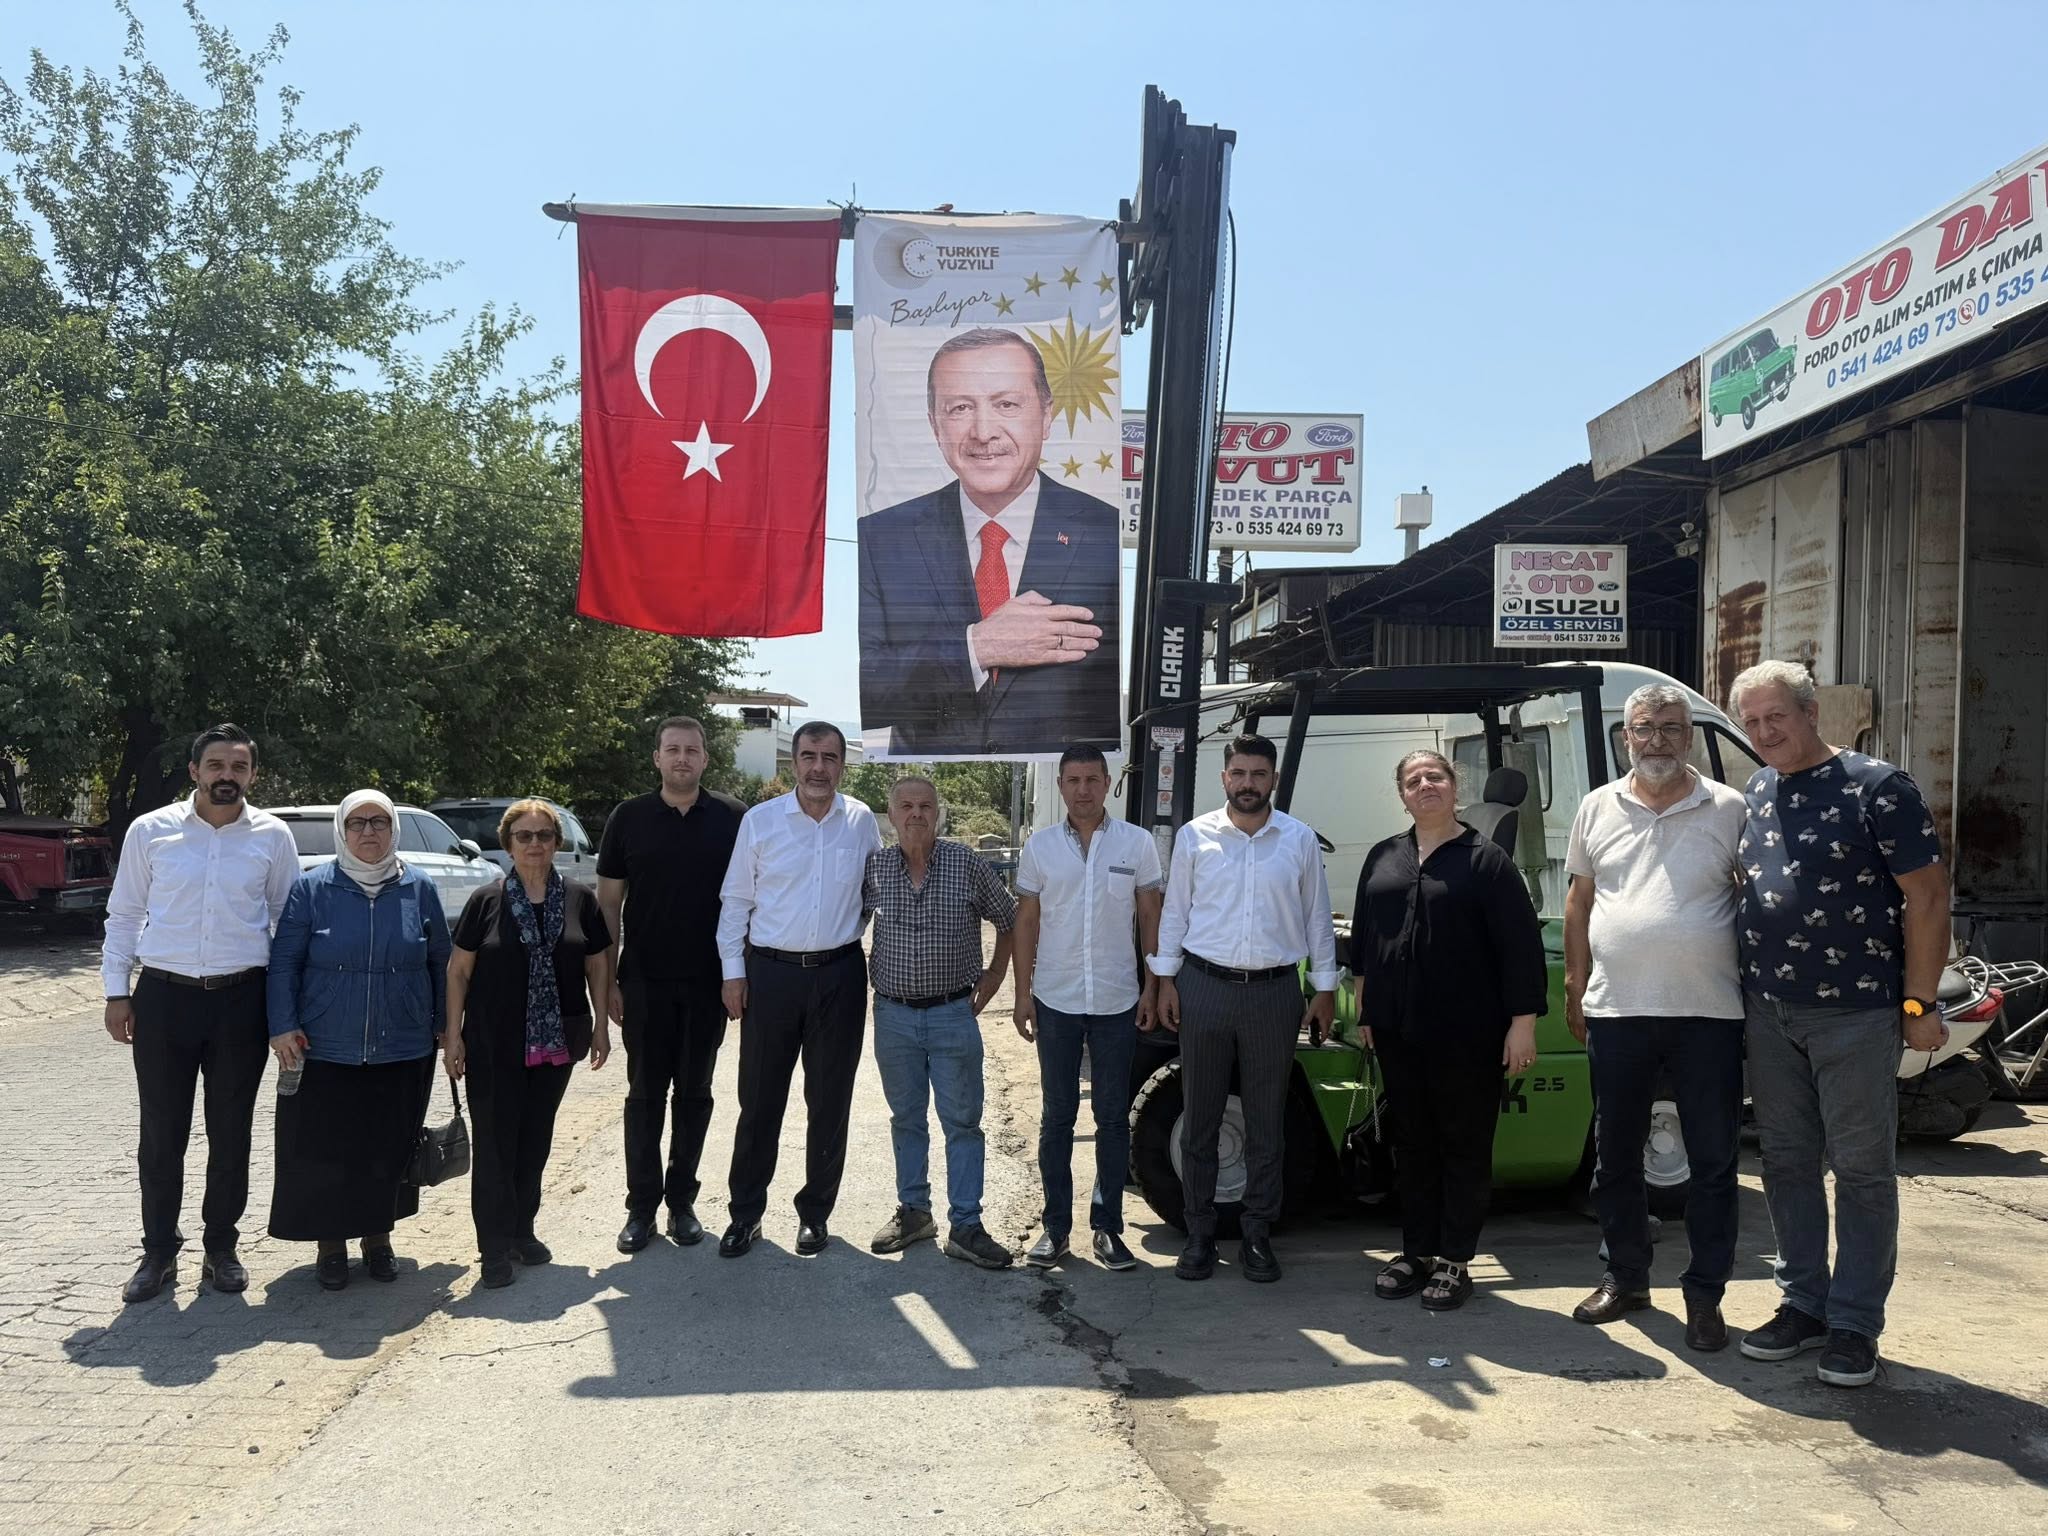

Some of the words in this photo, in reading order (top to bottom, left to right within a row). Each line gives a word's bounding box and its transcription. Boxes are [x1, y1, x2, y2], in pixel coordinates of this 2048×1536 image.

[1803, 341, 1839, 373] FORD
[1842, 325, 1870, 353] OTO
[1872, 301, 1910, 339] ALIM
[1913, 274, 1964, 316] SATIM
[1966, 267, 1977, 290] &
[1982, 233, 2043, 284] ÇIKMA
[1805, 247, 1913, 340] OTO
[890, 290, 992, 328] Başlıyor
[1827, 368, 1836, 389] 0
[1840, 352, 1867, 382] 541
[1872, 335, 1903, 365] 424
[1907, 322, 1929, 349] 69
[1935, 308, 1957, 337] 73
[1977, 292, 1989, 316] 0
[1995, 268, 2035, 307] 535
[1217, 421, 1291, 452] TO
[1314, 427, 1349, 443] Ford
[1122, 445, 1354, 485] DVUT
[1275, 490, 1352, 506] PARÇA
[1249, 505, 1330, 519] SATIMI
[1236, 522, 1244, 534] 0
[1248, 522, 1273, 534] 535
[1277, 523, 1302, 535] 424
[1306, 523, 1322, 536] 69
[1327, 524, 1343, 536] 73
[1511, 551, 1613, 571] NECAT
[1528, 574, 1594, 594] OTO
[1525, 599, 1620, 615] ISUZU
[1505, 617, 1549, 630] ÖZEL
[1553, 618, 1617, 631] SERVİSİ
[1554, 634, 1575, 642] 0541
[1578, 634, 1595, 642] 537
[1597, 634, 1607, 642] 20
[1609, 634, 1620, 642] 26
[1160, 626, 1184, 698] CLARK
[1533, 1077, 1565, 1092] 2.5
